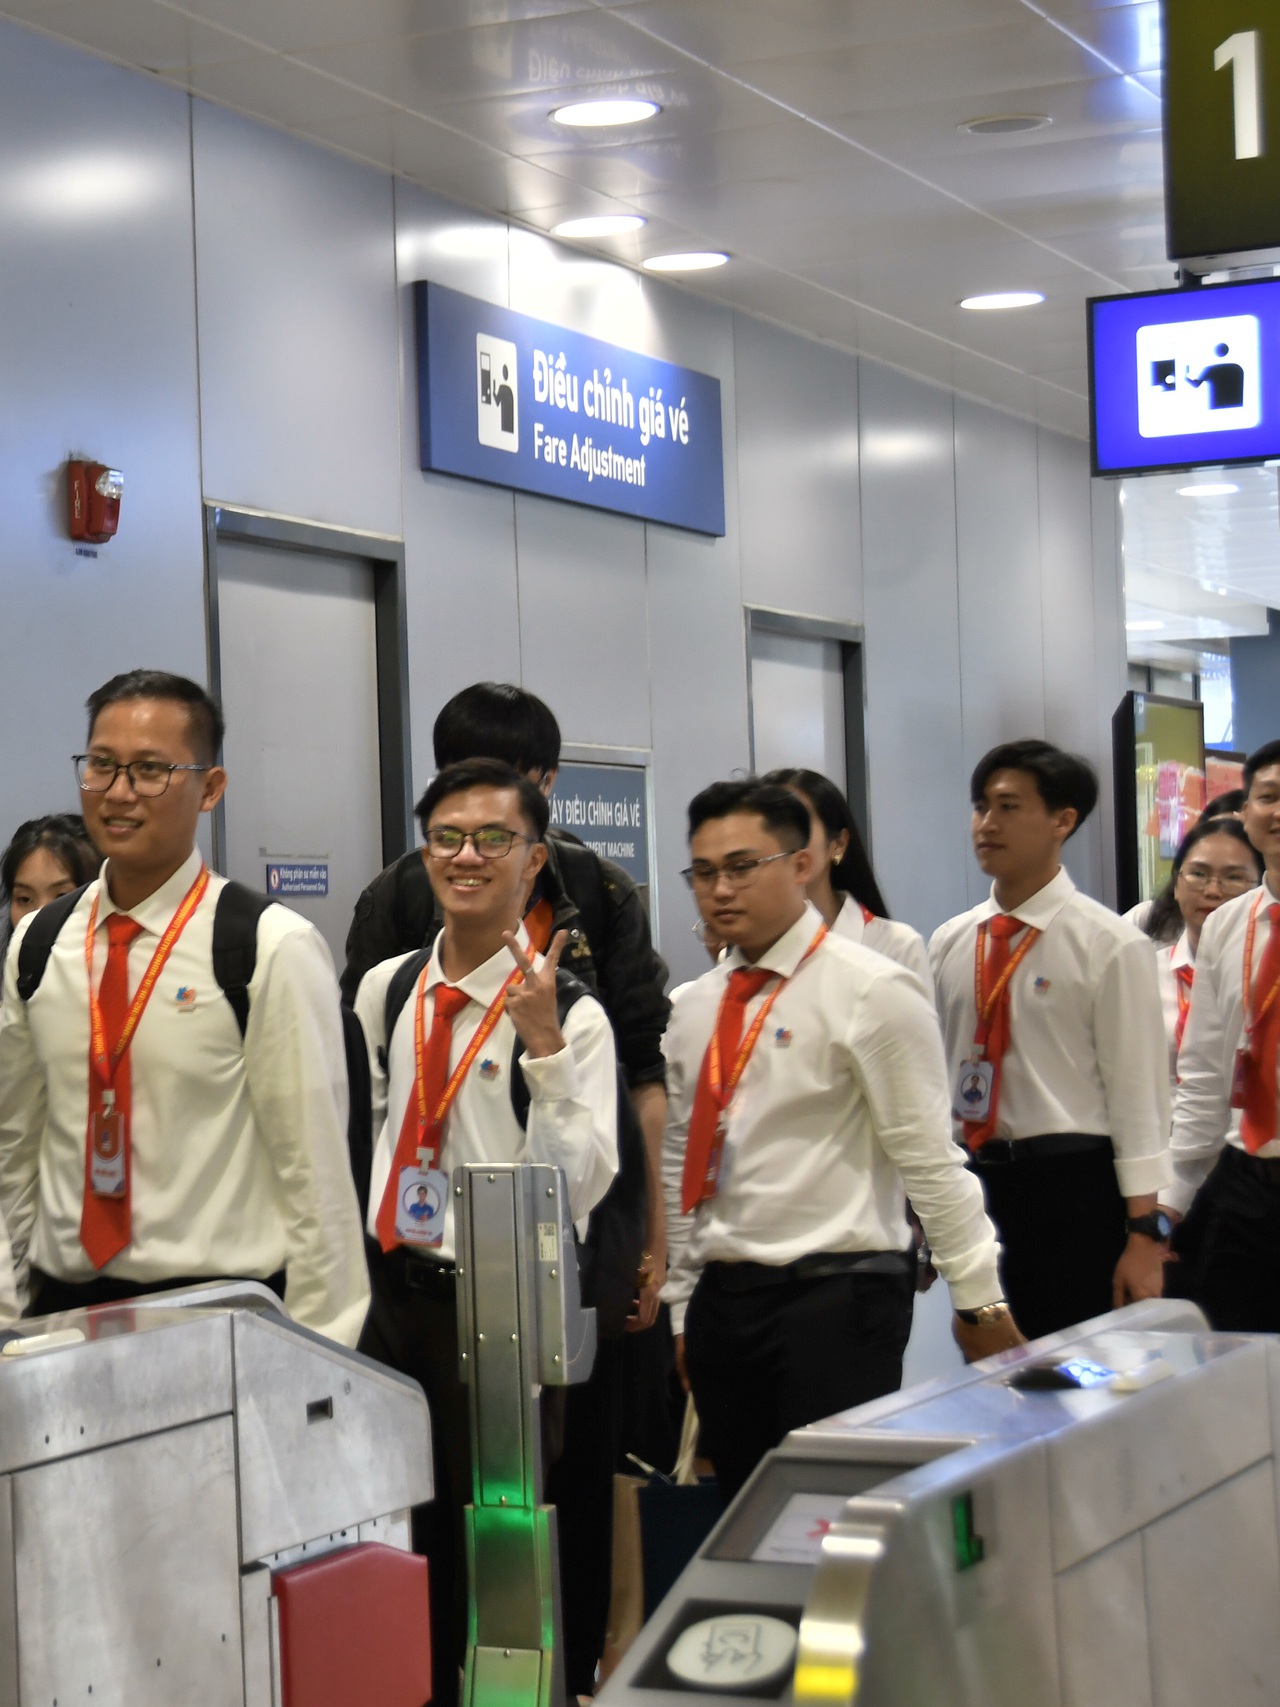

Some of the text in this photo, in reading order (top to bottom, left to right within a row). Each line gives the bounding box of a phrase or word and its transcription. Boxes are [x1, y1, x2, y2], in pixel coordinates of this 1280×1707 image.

[1213, 30, 1259, 161] 1
[533, 349, 689, 446] Điều chỉnh giá vé
[534, 422, 646, 487] Fare Adjustment
[614, 796, 629, 827] GIÁ
